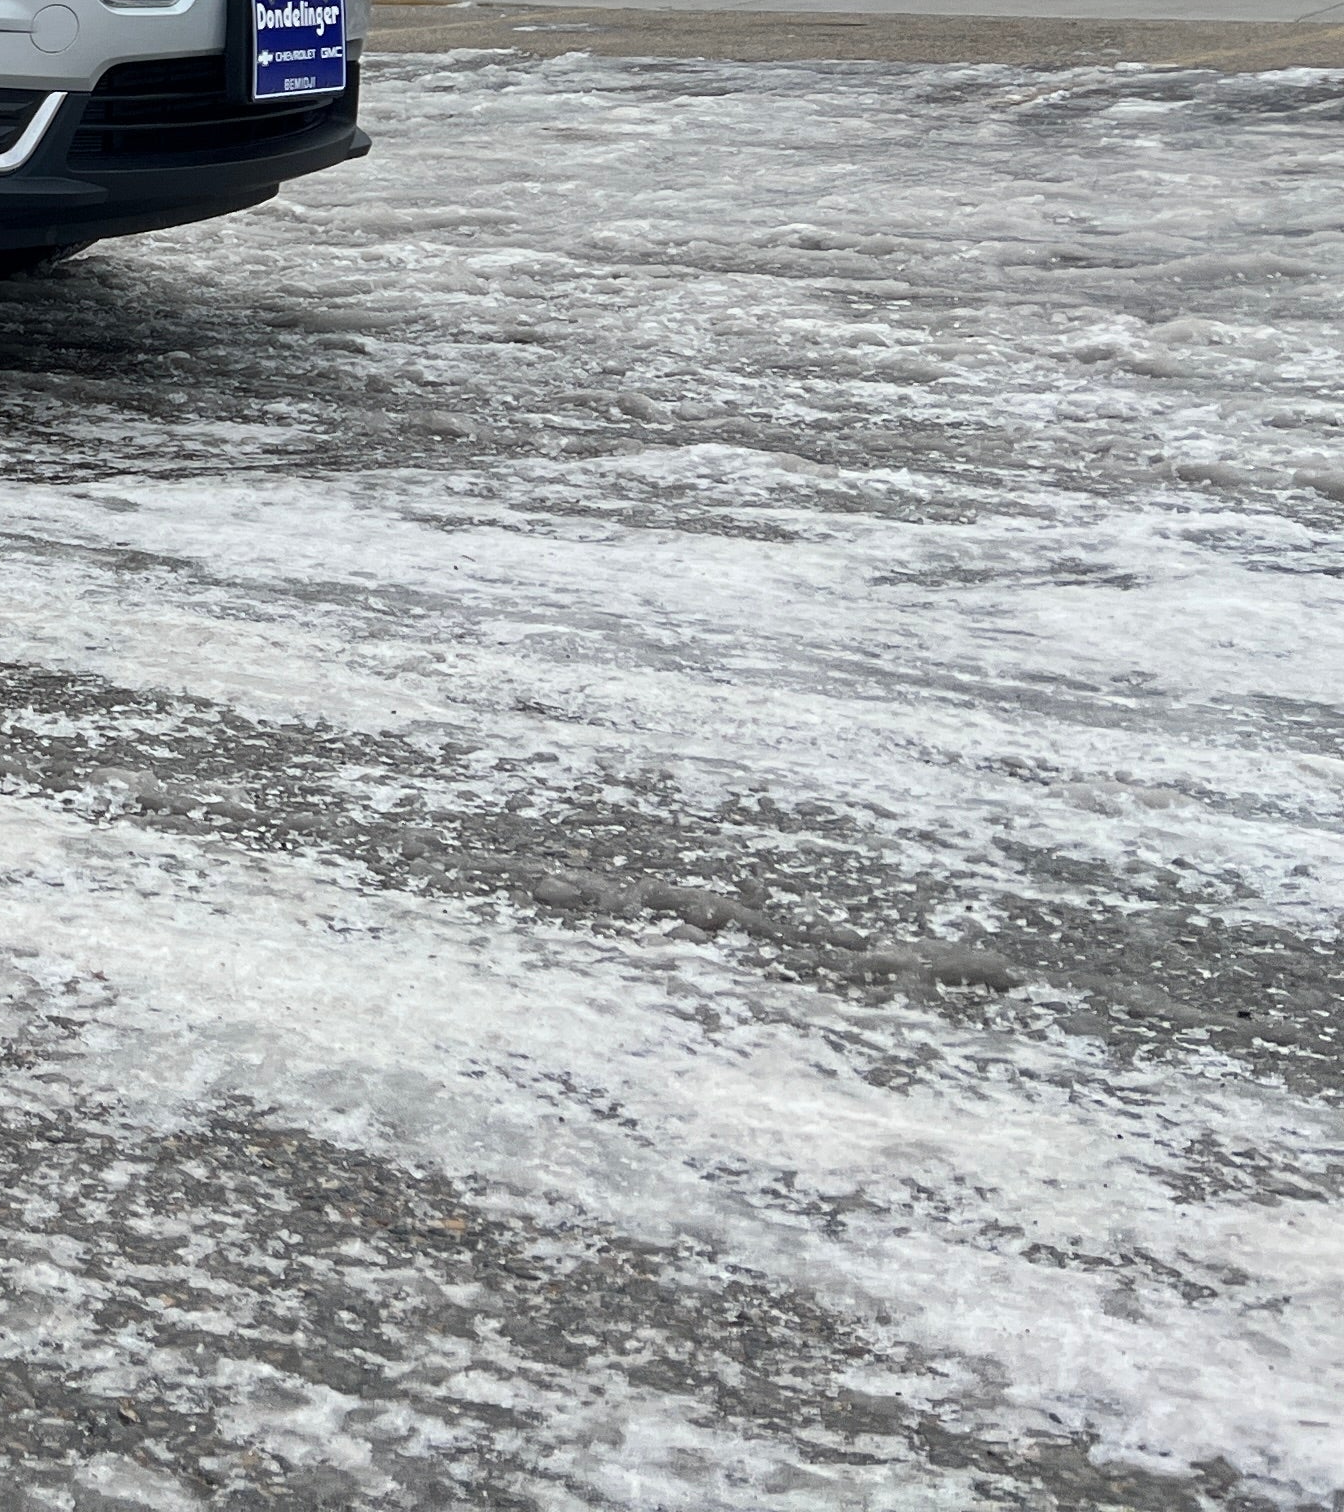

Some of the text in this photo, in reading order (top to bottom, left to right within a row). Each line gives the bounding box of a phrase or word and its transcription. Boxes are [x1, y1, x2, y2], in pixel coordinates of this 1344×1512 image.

[256, 0, 341, 37] Dondelinger
[275, 45, 344, 63] CHEVROLET GMC
[283, 75, 317, 91] BEMIDJI
